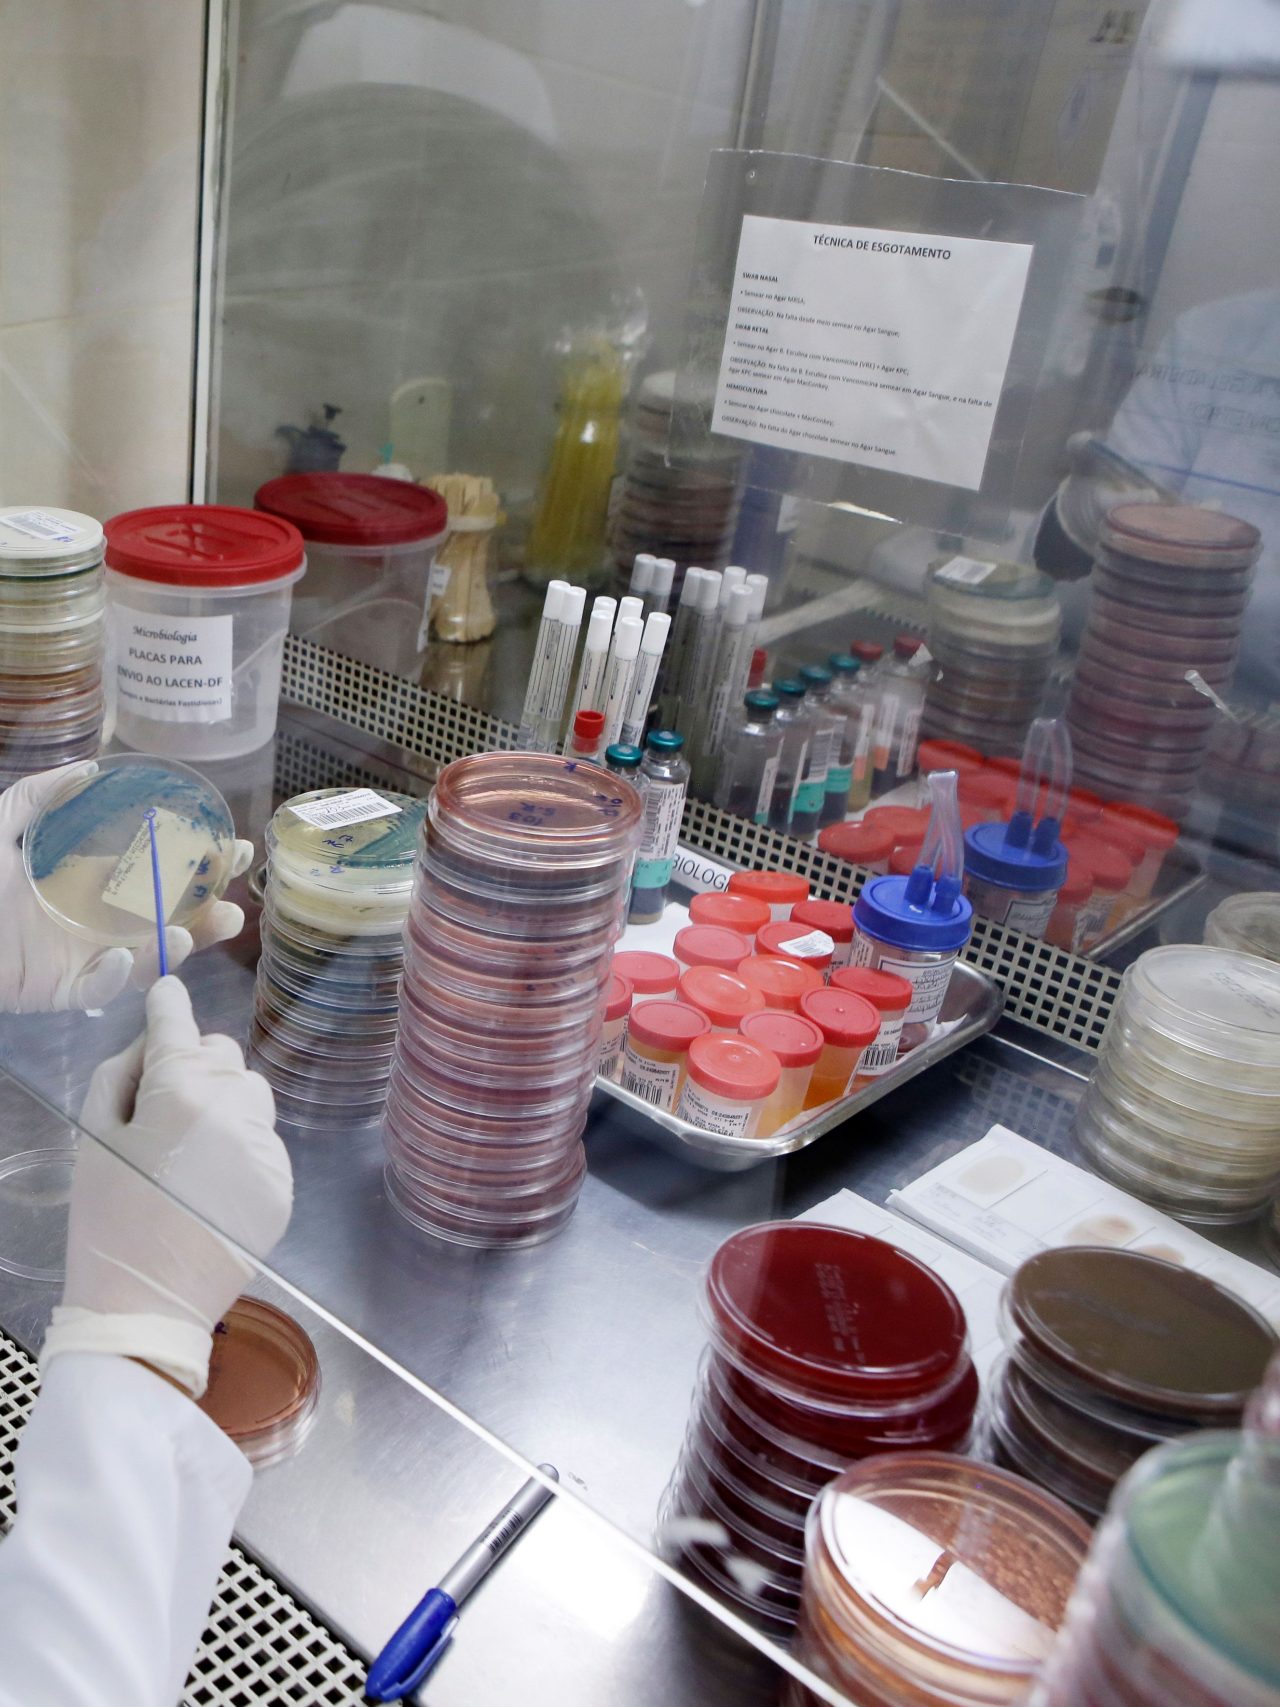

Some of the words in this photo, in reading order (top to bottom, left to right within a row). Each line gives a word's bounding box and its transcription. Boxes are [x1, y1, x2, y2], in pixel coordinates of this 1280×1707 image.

[814, 234, 853, 249] TÉCNICA
[856, 240, 870, 251] DE
[871, 242, 951, 260] ESGOTAMENTO
[133, 626, 198, 645] Microbiologia
[129, 647, 167, 664] PLACAS
[170, 655, 203, 665] PARA
[146, 675, 162, 686] AO
[166, 677, 223, 689] LACEN-DF
